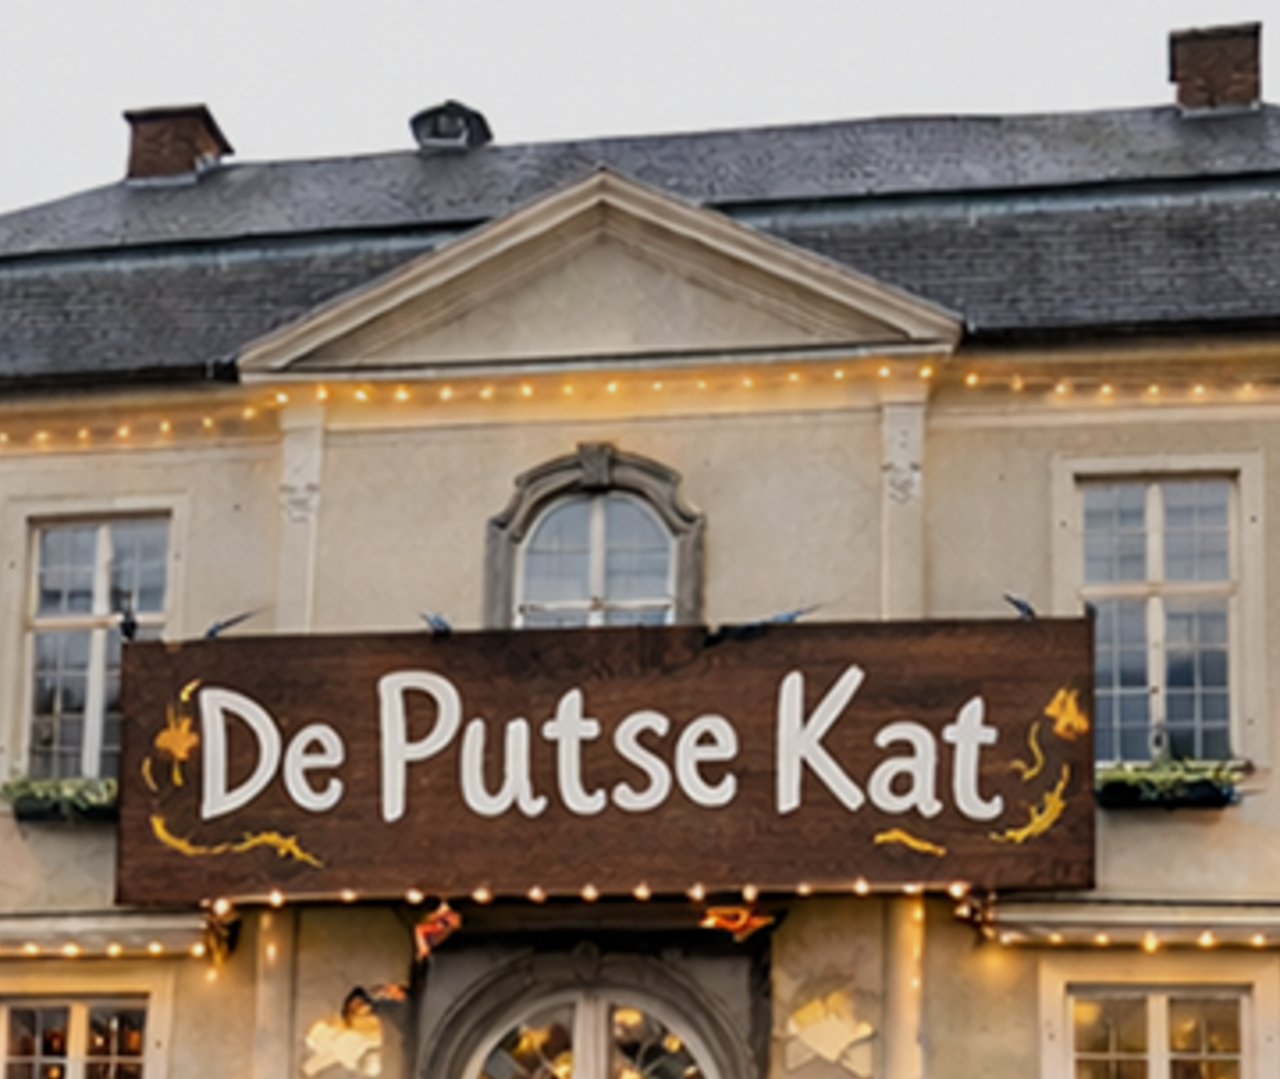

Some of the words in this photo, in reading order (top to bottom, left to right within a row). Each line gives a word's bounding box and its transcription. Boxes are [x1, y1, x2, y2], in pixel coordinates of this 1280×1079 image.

[199, 686, 344, 820] De
[377, 669, 739, 822] Putse
[776, 664, 1004, 820] Kat
